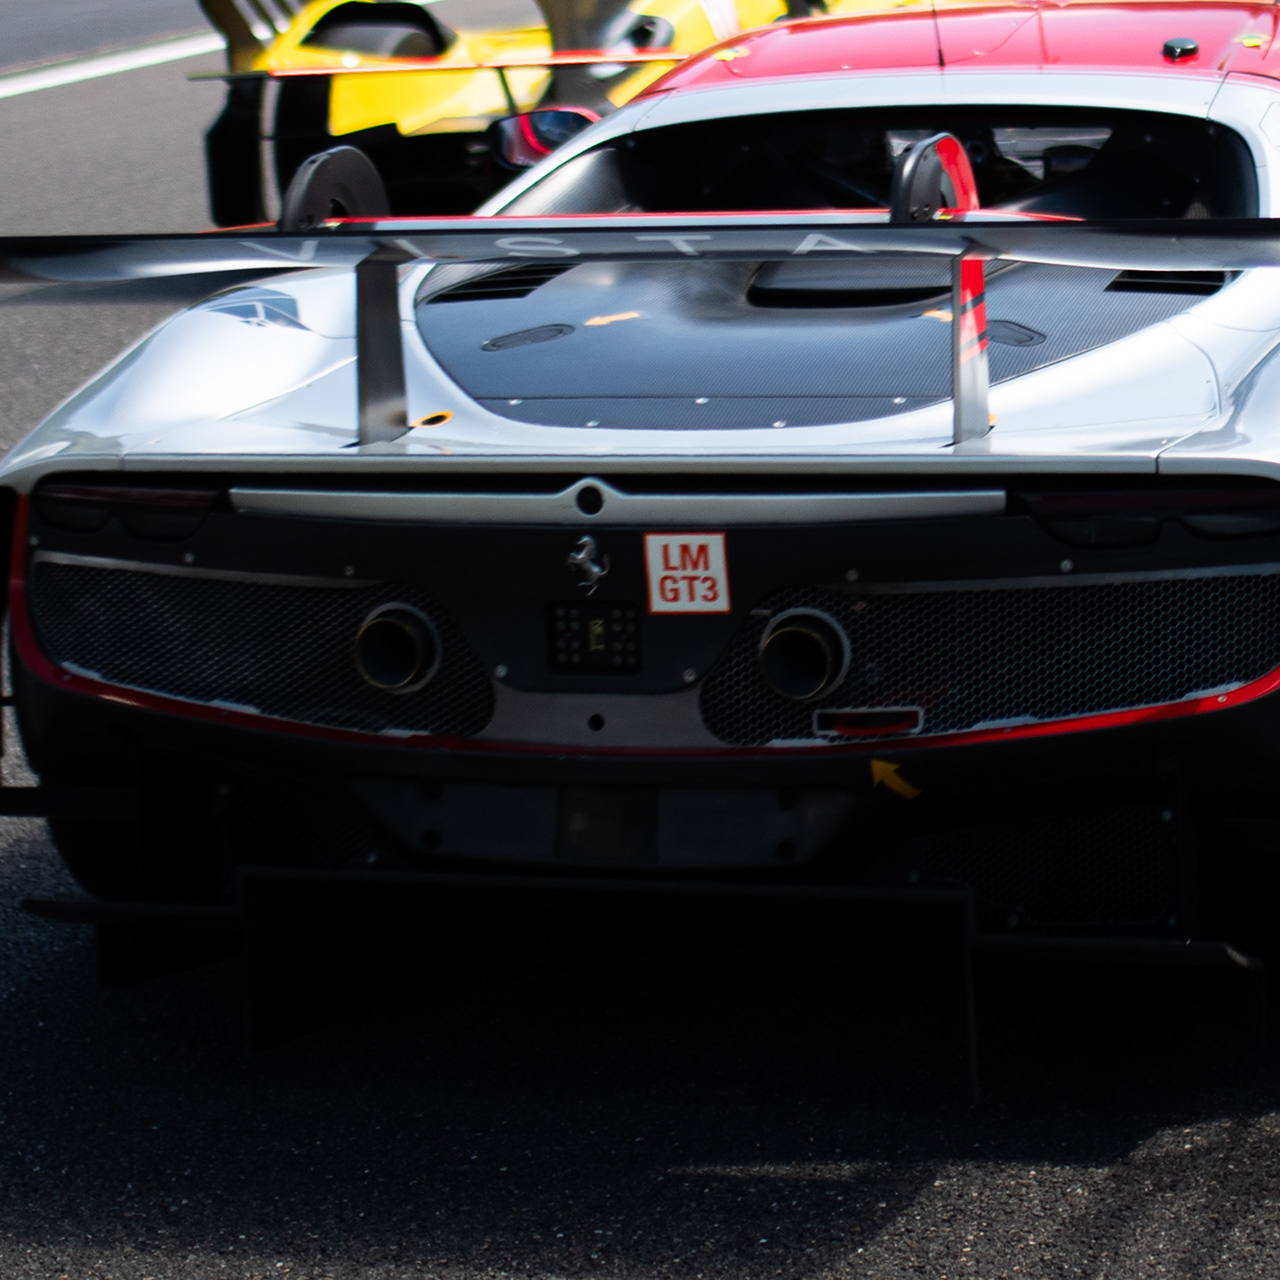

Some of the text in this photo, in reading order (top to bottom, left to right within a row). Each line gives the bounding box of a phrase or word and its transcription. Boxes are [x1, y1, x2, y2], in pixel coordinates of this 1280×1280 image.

[239, 231, 880, 259] VISTA
[661, 542, 711, 572] LM
[658, 575, 720, 604] GT3
